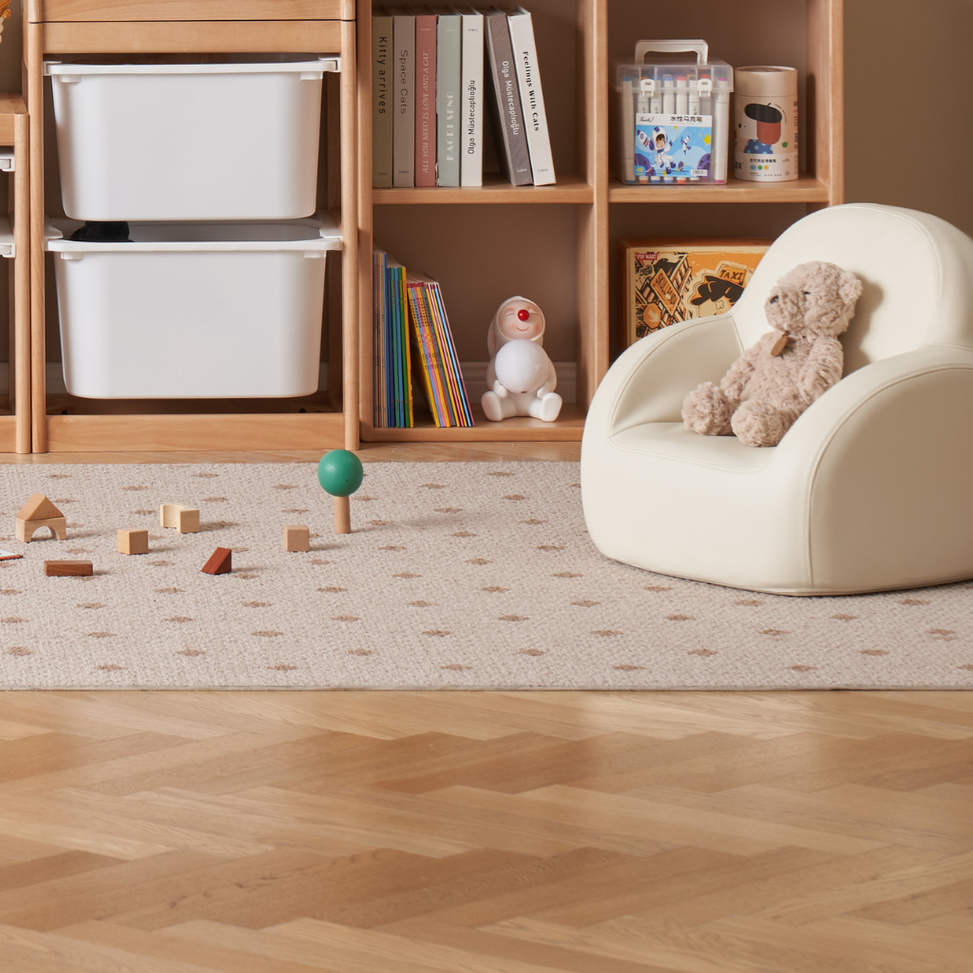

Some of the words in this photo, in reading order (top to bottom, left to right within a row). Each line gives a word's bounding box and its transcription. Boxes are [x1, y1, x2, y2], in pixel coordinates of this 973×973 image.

[377, 37, 387, 65] Kitty
[399, 49, 408, 84] Space
[523, 51, 532, 87] Feelings
[379, 69, 387, 114] arrives
[423, 112, 429, 120] IS
[468, 138, 476, 154] Olga
[720, 270, 743, 280] TAXI
